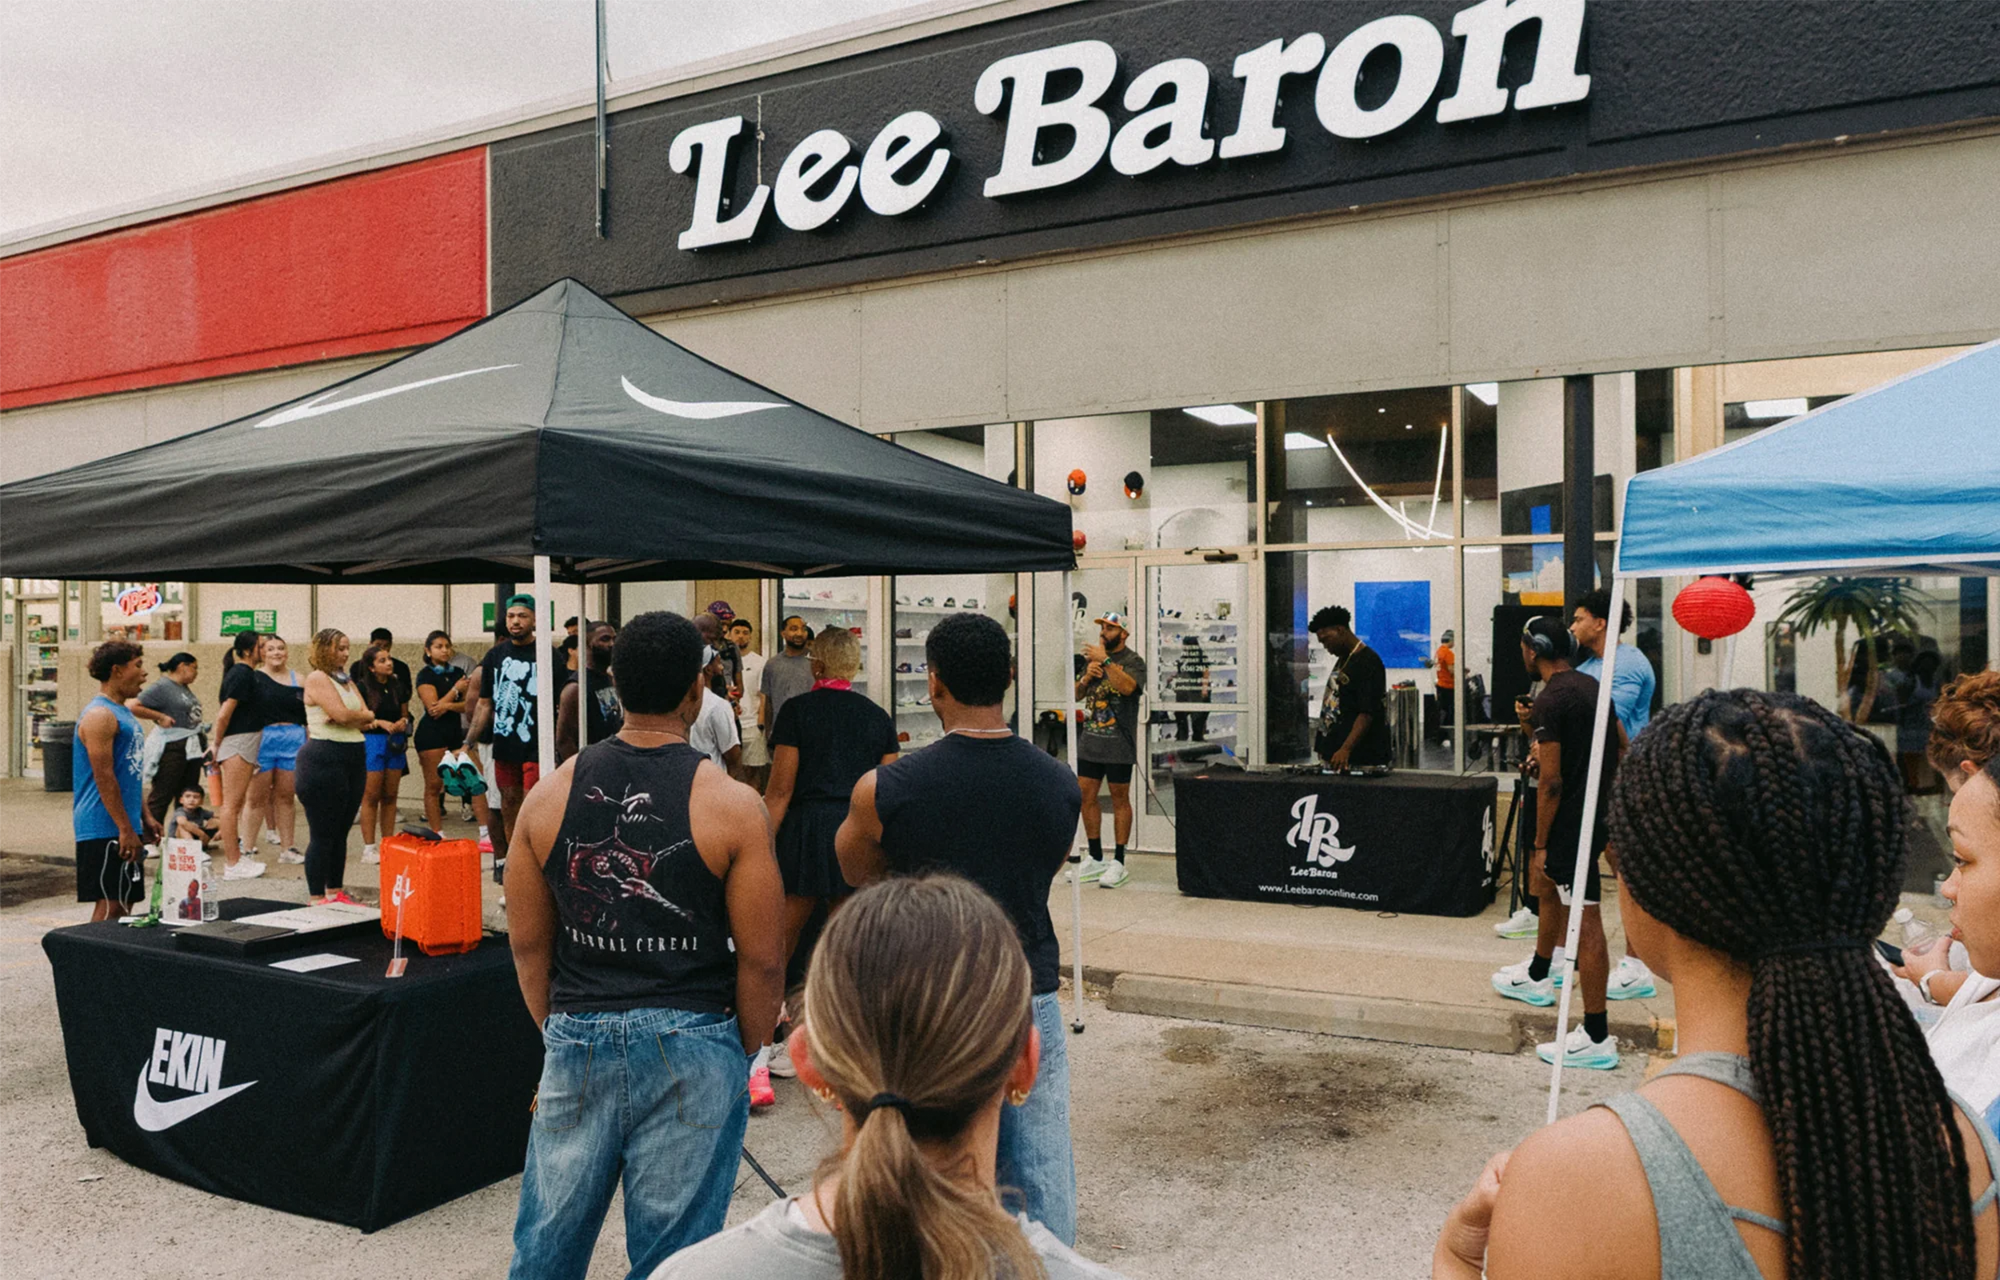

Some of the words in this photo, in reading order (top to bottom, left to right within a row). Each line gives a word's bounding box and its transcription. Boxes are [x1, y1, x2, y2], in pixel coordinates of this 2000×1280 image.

[669, 110, 951, 250] Lee
[974, 0, 1591, 198] Baron
[119, 584, 160, 616] OPEN
[254, 611, 275, 624] FREE
[177, 846, 187, 855] NO
[168, 863, 177, 871] NO
[179, 864, 197, 872] DEMO
[1258, 884, 1379, 901] www.Leebarononline.com
[148, 1027, 227, 1094] EKIN
